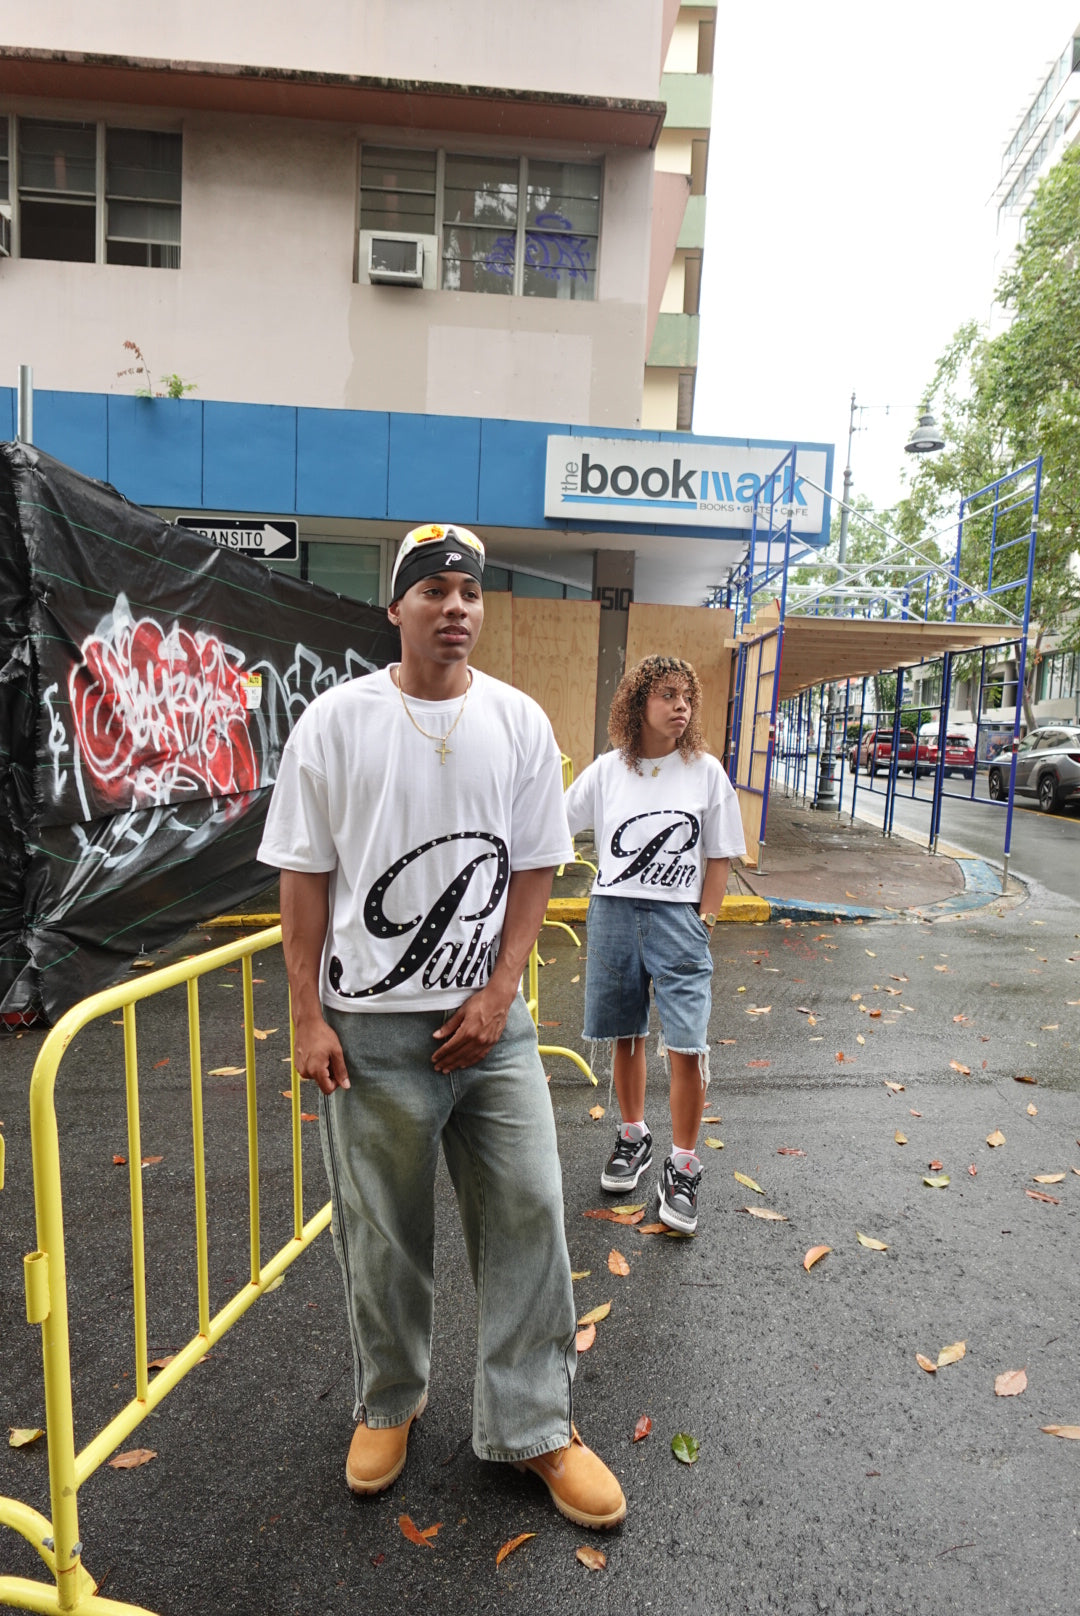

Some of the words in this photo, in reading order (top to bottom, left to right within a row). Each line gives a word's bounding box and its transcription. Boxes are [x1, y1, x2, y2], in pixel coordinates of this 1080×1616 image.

[561, 461, 579, 492] the
[580, 453, 808, 506] bookmark
[700, 503, 735, 512] BOOKS
[743, 505, 772, 514] GITS
[193, 529, 263, 547] RANSITO
[597, 810, 700, 888] Palm
